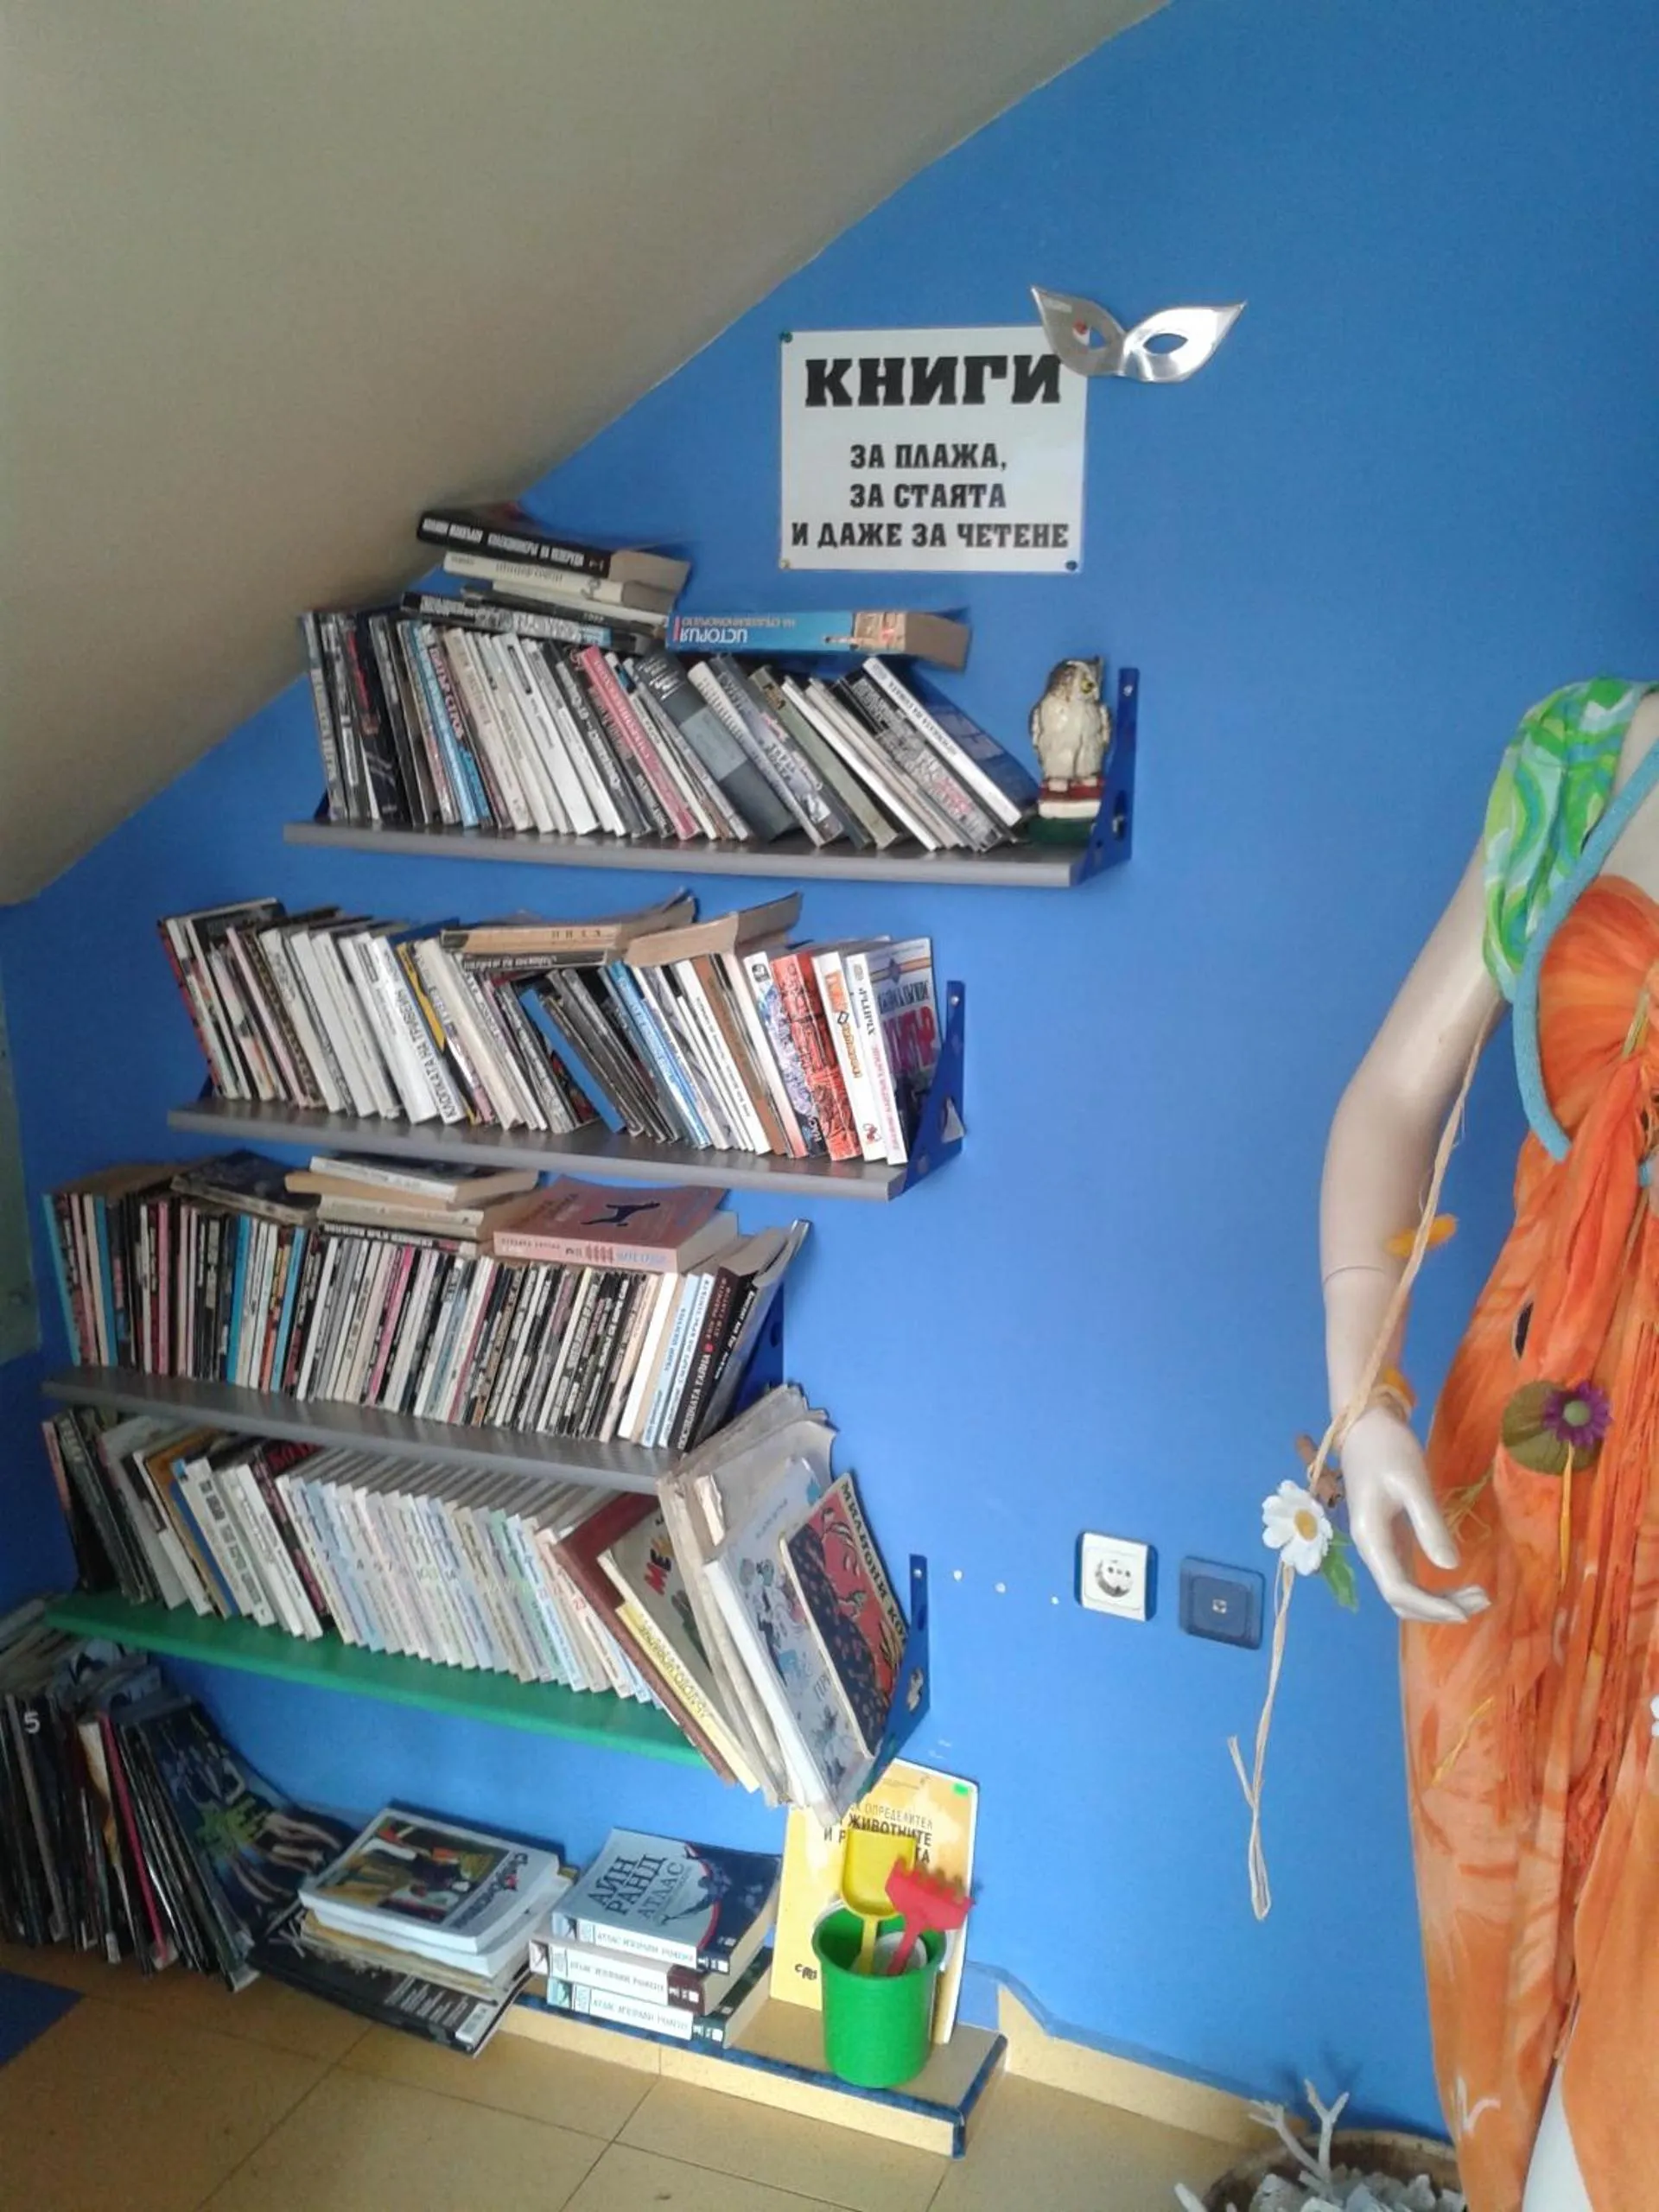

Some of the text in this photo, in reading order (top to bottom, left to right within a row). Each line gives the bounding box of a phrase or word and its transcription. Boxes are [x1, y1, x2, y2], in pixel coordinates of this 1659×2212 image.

[804, 354, 1063, 407] КНИГИ
[850, 443, 1007, 472] ЗА ПЛАЖА,
[849, 483, 1007, 508] ЗА СТАЯТА
[791, 523, 1070, 549] И ДАЖЕ ЗА ЧЕТЕНЕ
[24, 1710, 41, 1734] 5
[848, 1814, 933, 1847] ЖИВОТНИТЕ
[606, 1854, 666, 1916] РАНД
[638, 1861, 684, 1919] АТЛАС
